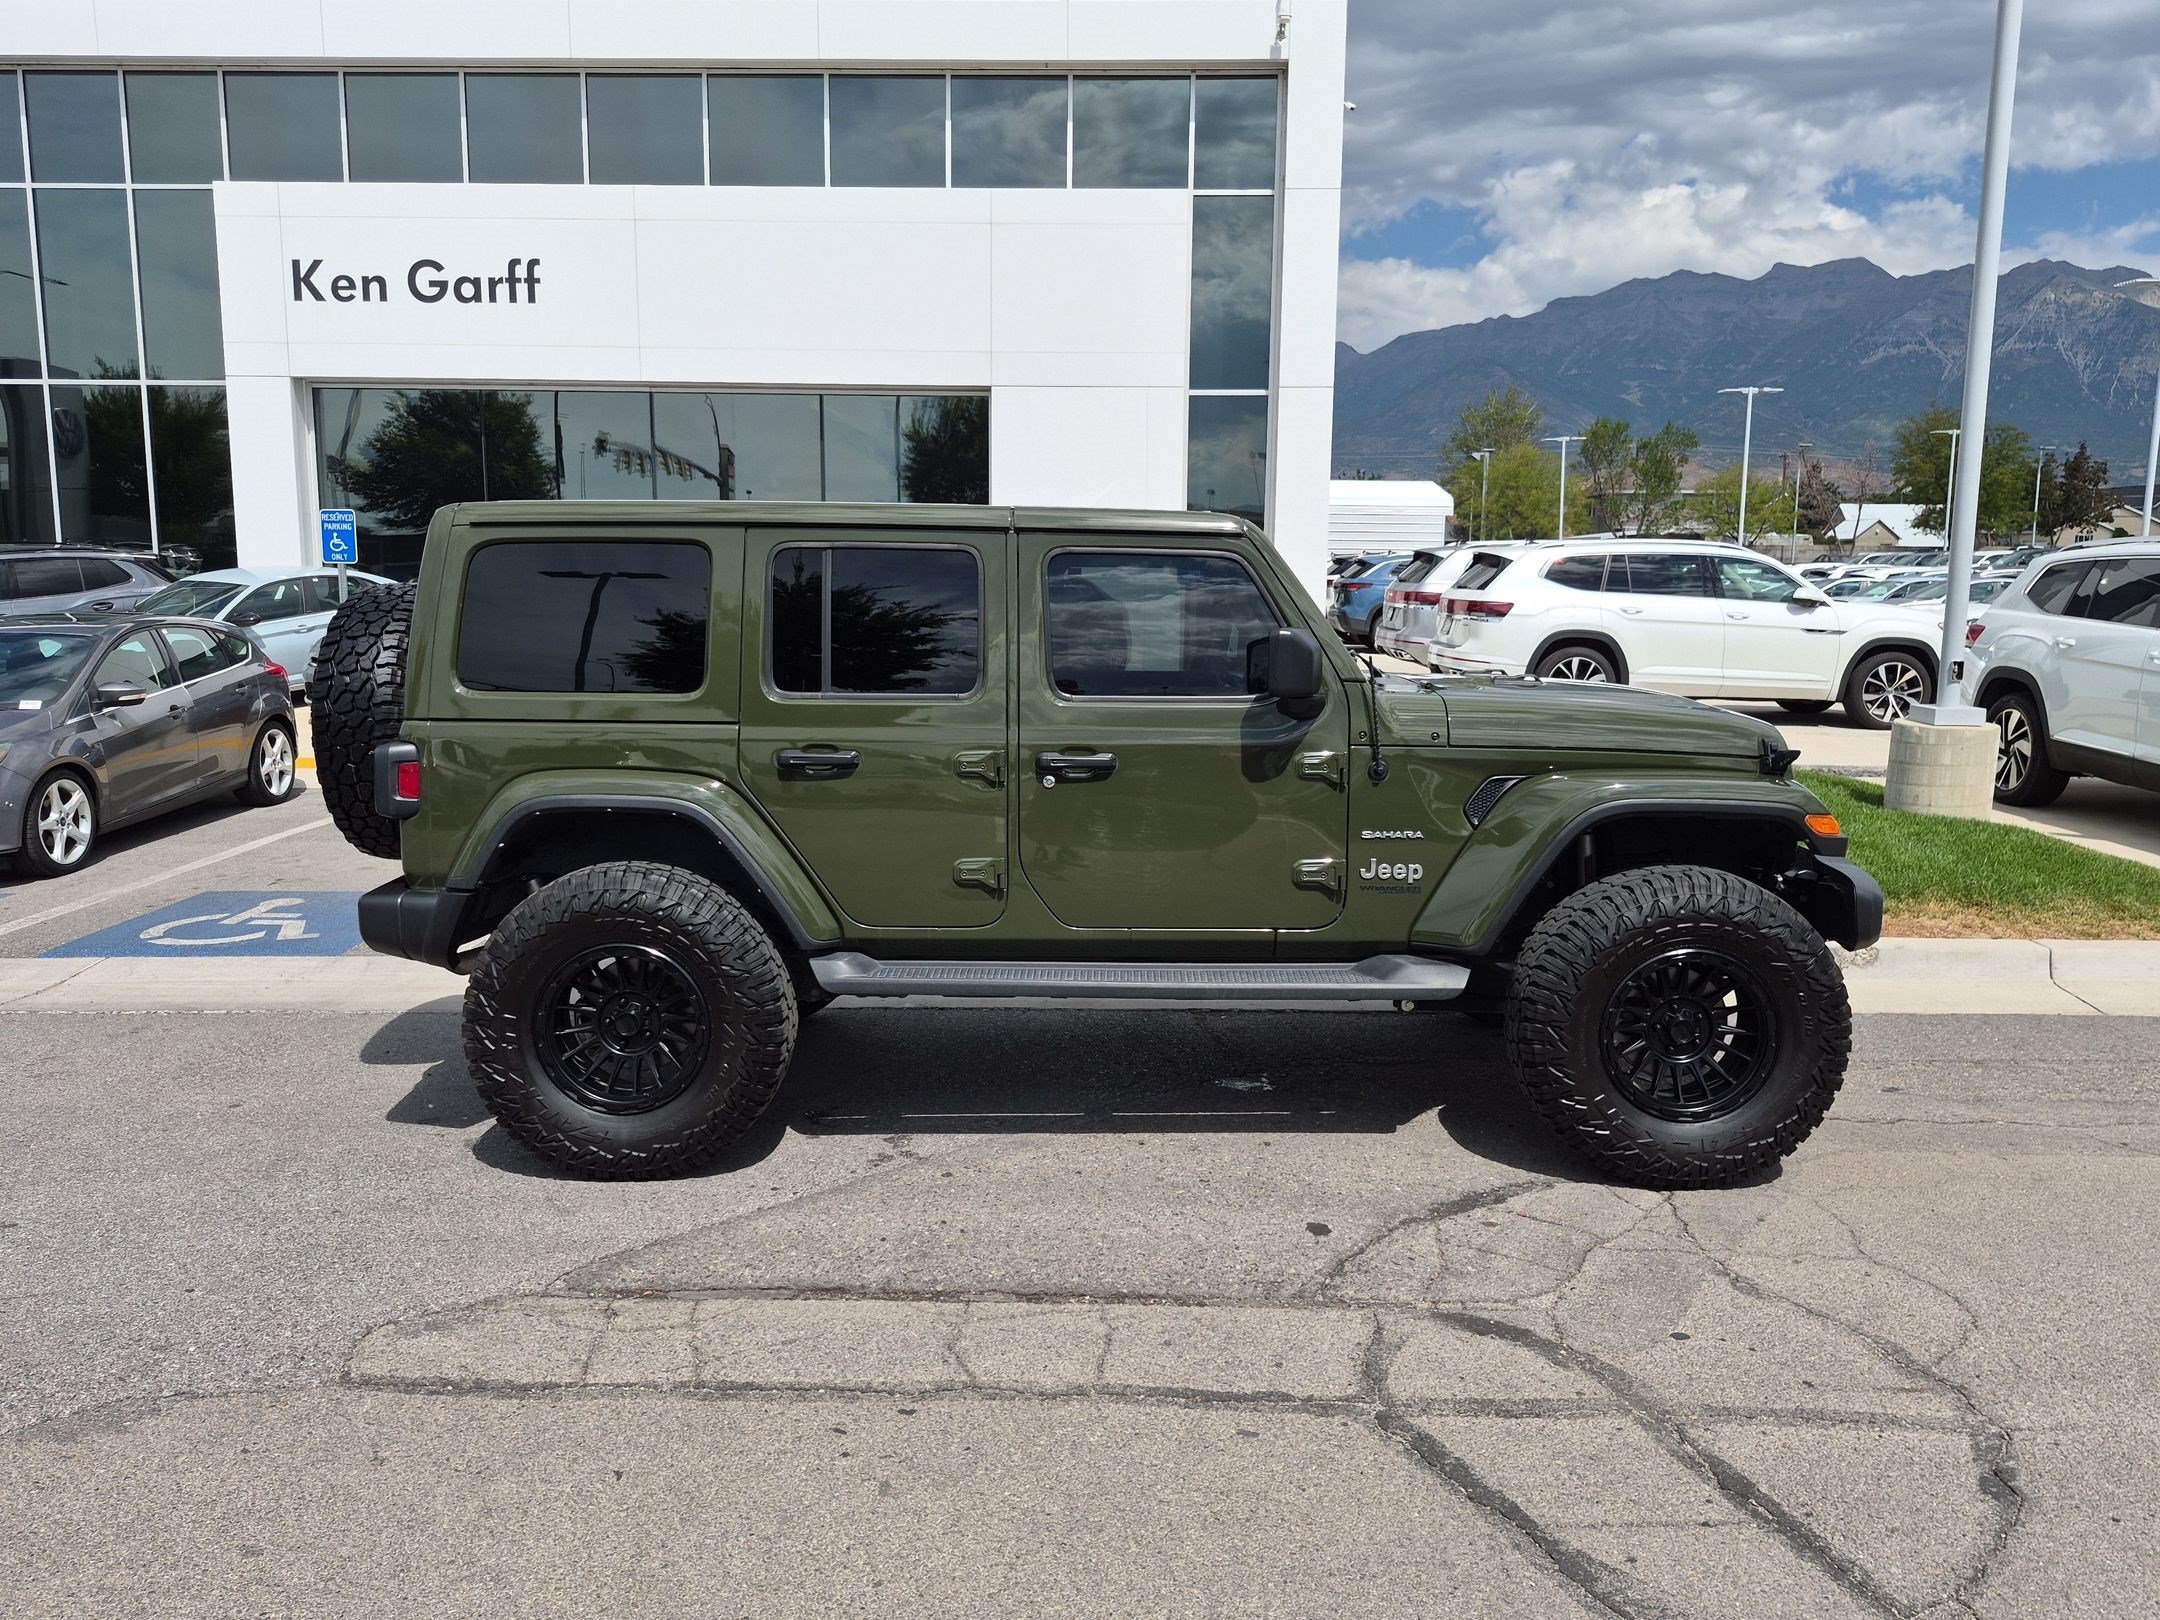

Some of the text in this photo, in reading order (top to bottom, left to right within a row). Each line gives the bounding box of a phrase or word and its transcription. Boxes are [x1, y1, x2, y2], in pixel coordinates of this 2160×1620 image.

[291, 258, 541, 304] Ken Garff
[1361, 830, 1424, 839] SAHARA
[1360, 858, 1423, 884] Jeep
